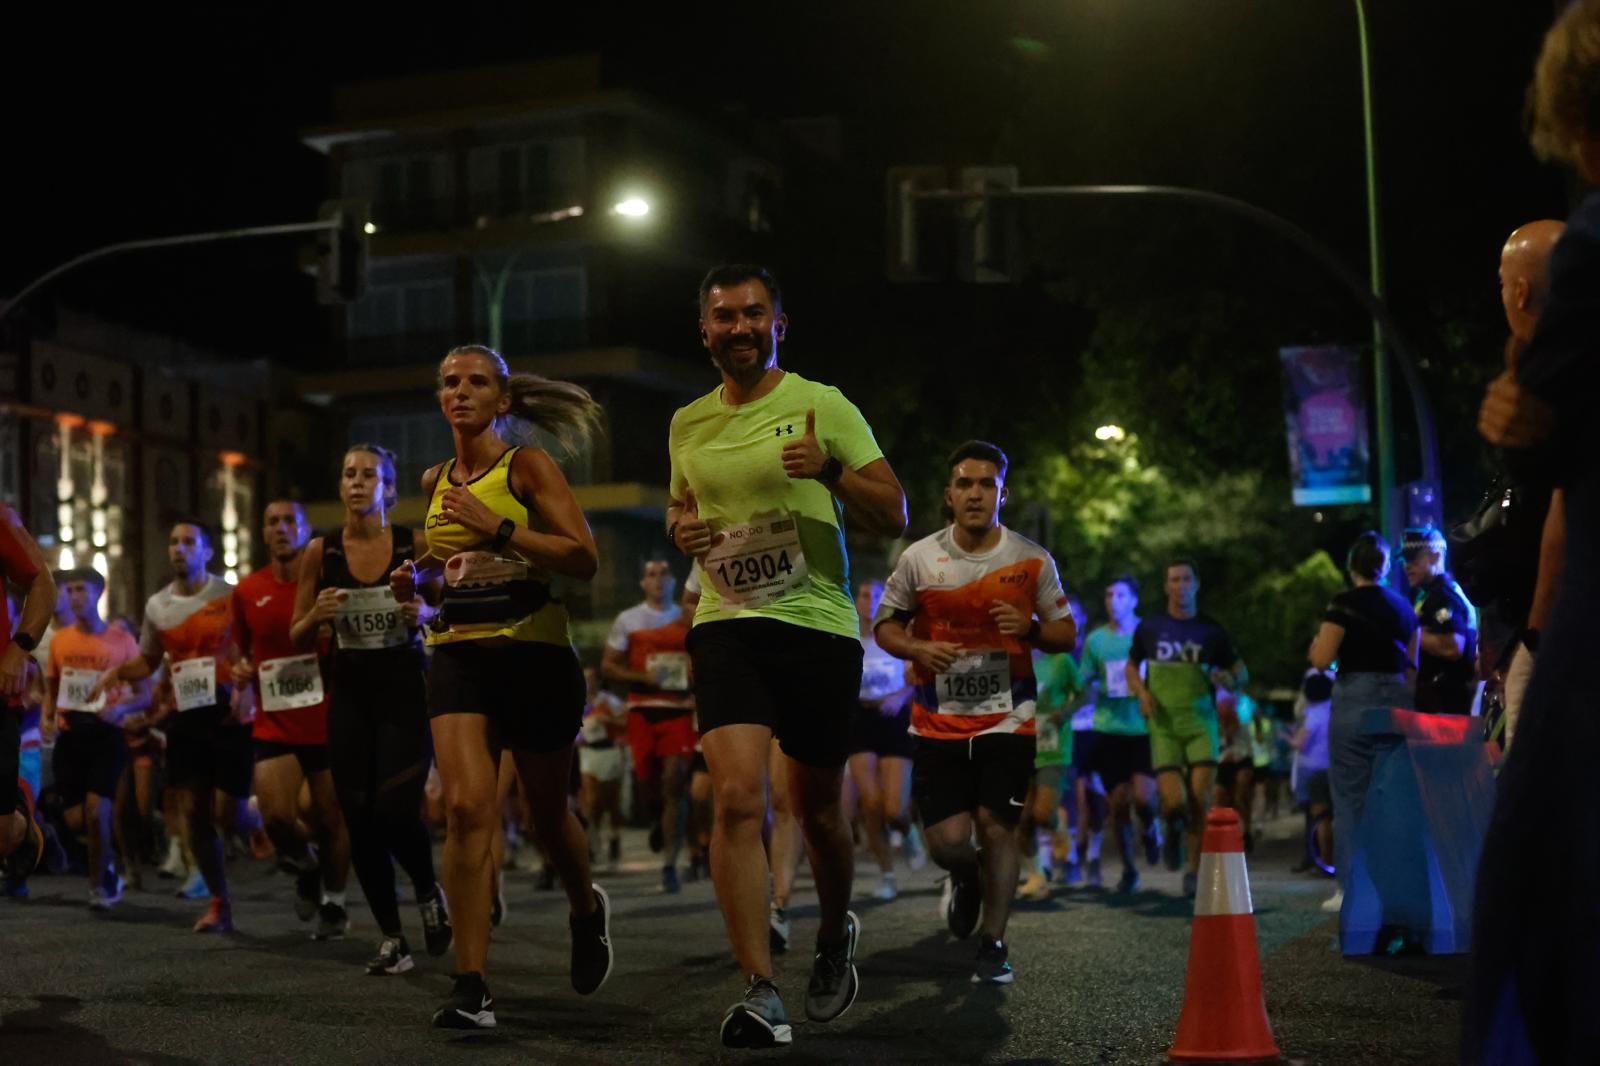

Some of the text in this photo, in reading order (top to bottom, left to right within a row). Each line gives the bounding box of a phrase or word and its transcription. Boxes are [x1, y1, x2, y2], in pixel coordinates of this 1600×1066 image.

[717, 550, 793, 587] 12904
[340, 612, 397, 632] 11589
[944, 675, 1001, 697] 12695
